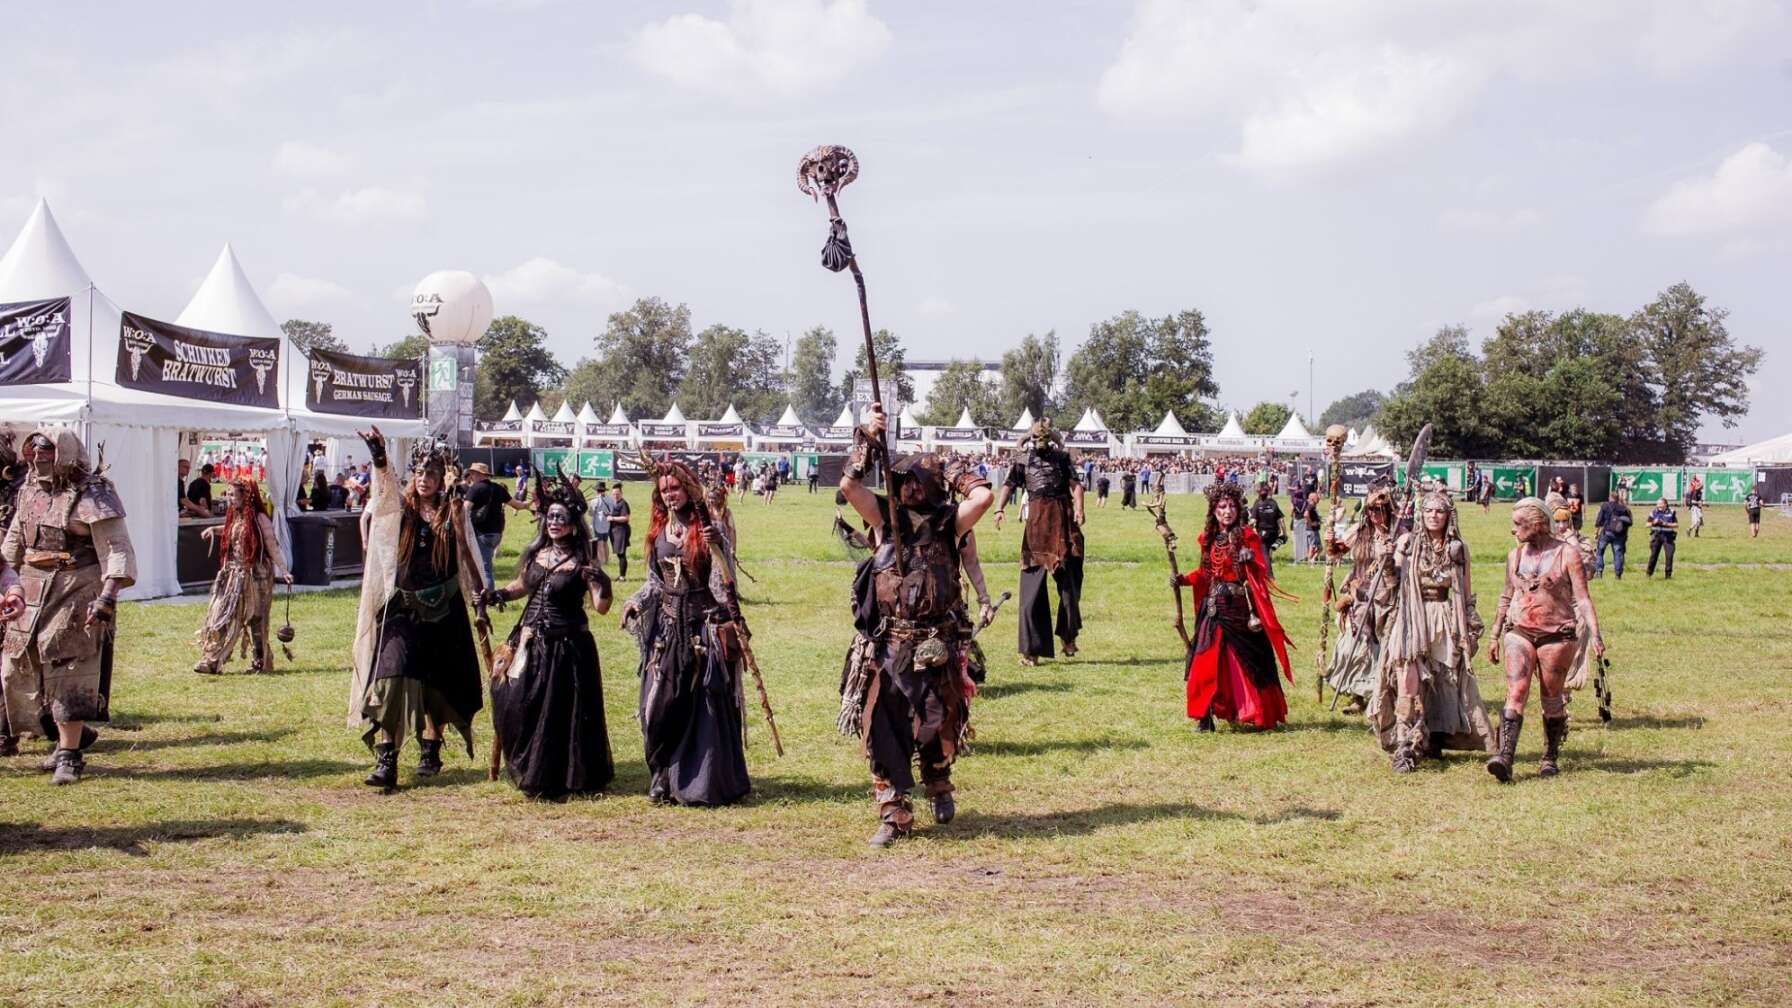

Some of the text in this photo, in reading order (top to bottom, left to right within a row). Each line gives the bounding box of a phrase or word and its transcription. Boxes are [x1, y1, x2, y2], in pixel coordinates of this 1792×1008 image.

[174, 340, 231, 367] SCHINKEN
[162, 360, 237, 389] BRATWURST
[332, 369, 395, 389] BRATWURST
[333, 389, 362, 400] GERMAN
